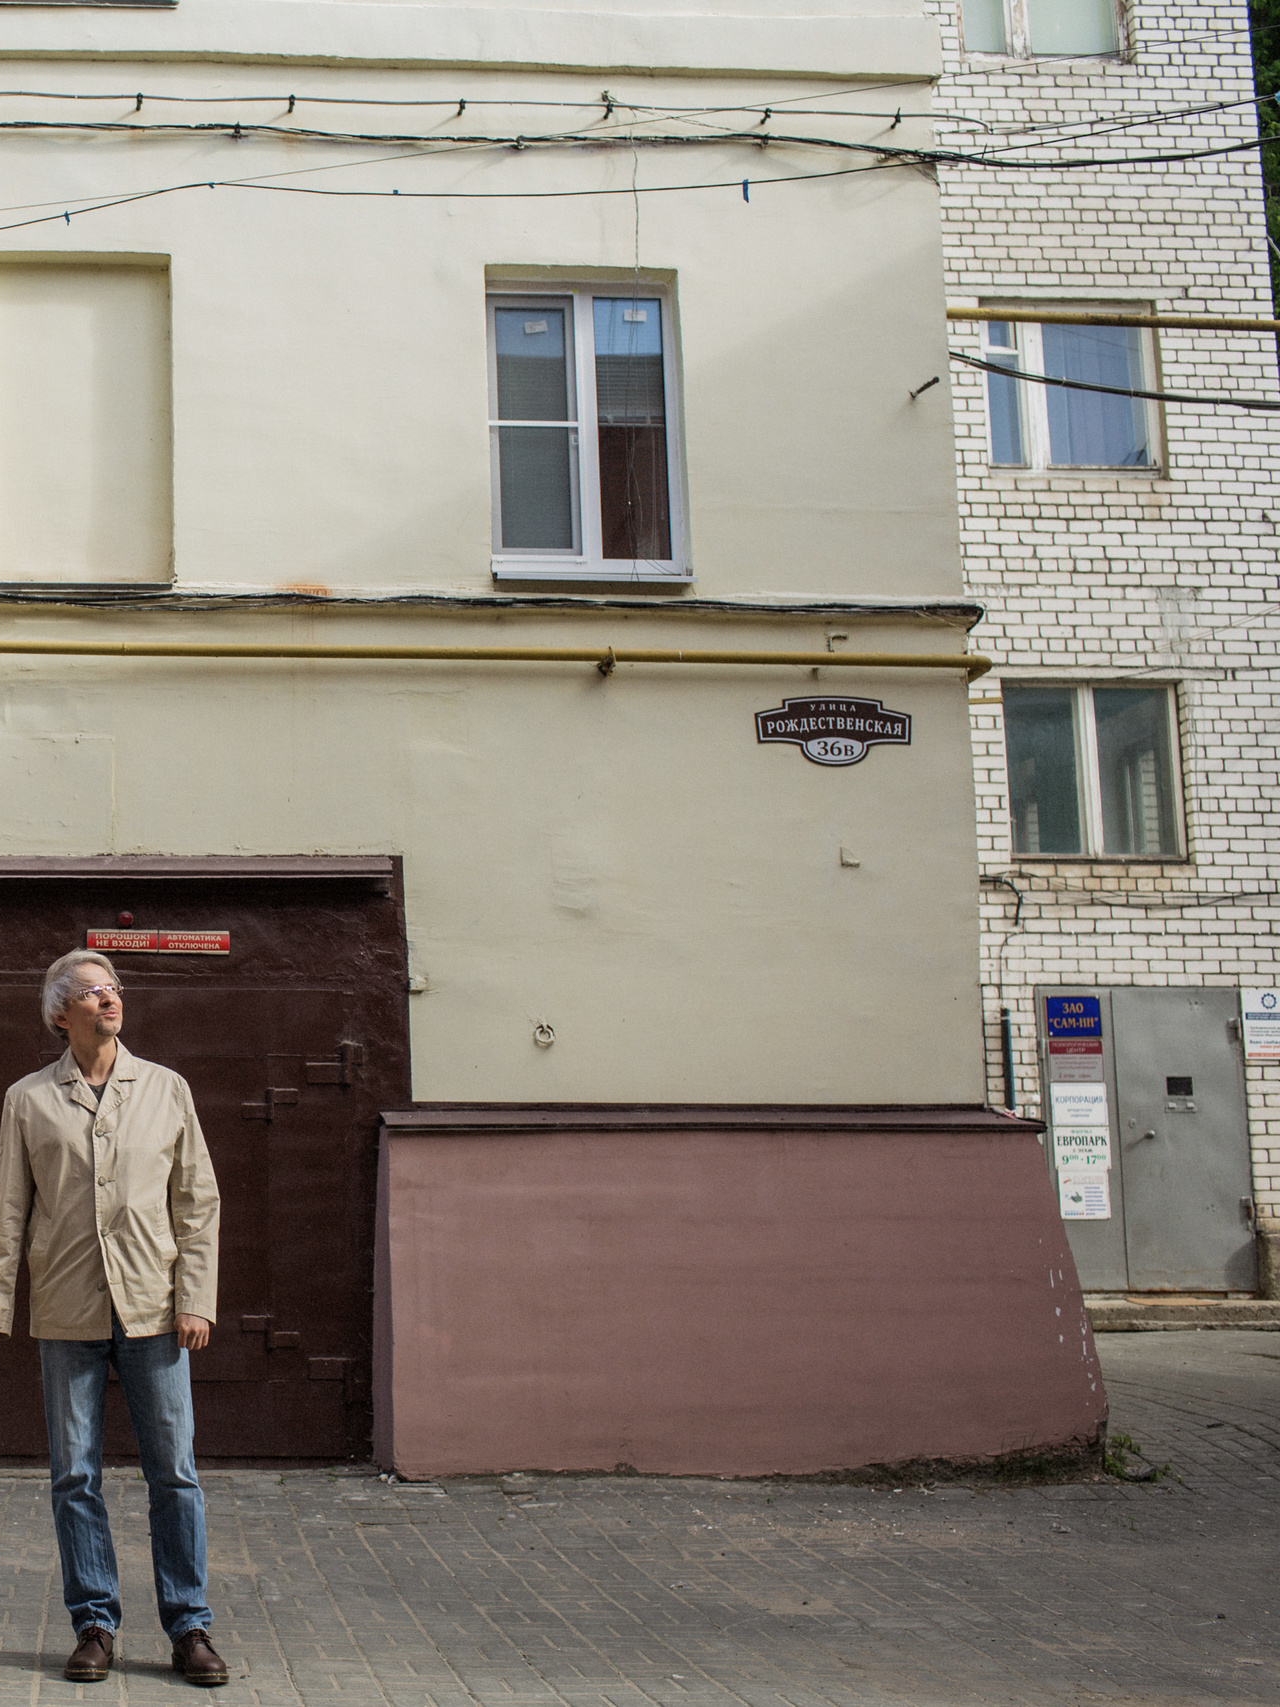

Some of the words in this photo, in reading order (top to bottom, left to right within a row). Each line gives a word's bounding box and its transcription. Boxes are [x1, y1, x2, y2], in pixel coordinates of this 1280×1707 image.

[809, 703, 857, 713] УЛИЦА
[766, 716, 903, 736] РОЖДЕСТВЕНСКАЯ
[95, 933, 150, 941] ПОРОШОК!
[167, 934, 222, 942] АВТОМАТИКА
[112, 940, 150, 948] ВХОДИ!
[168, 942, 220, 950] ОТКЛЮЧЕНА
[1062, 1002, 1084, 1014] ЗАО
[1055, 1095, 1103, 1104] КОРПОРАЦИЯ
[1057, 1135, 1107, 1147] ЕВРОПАРК
